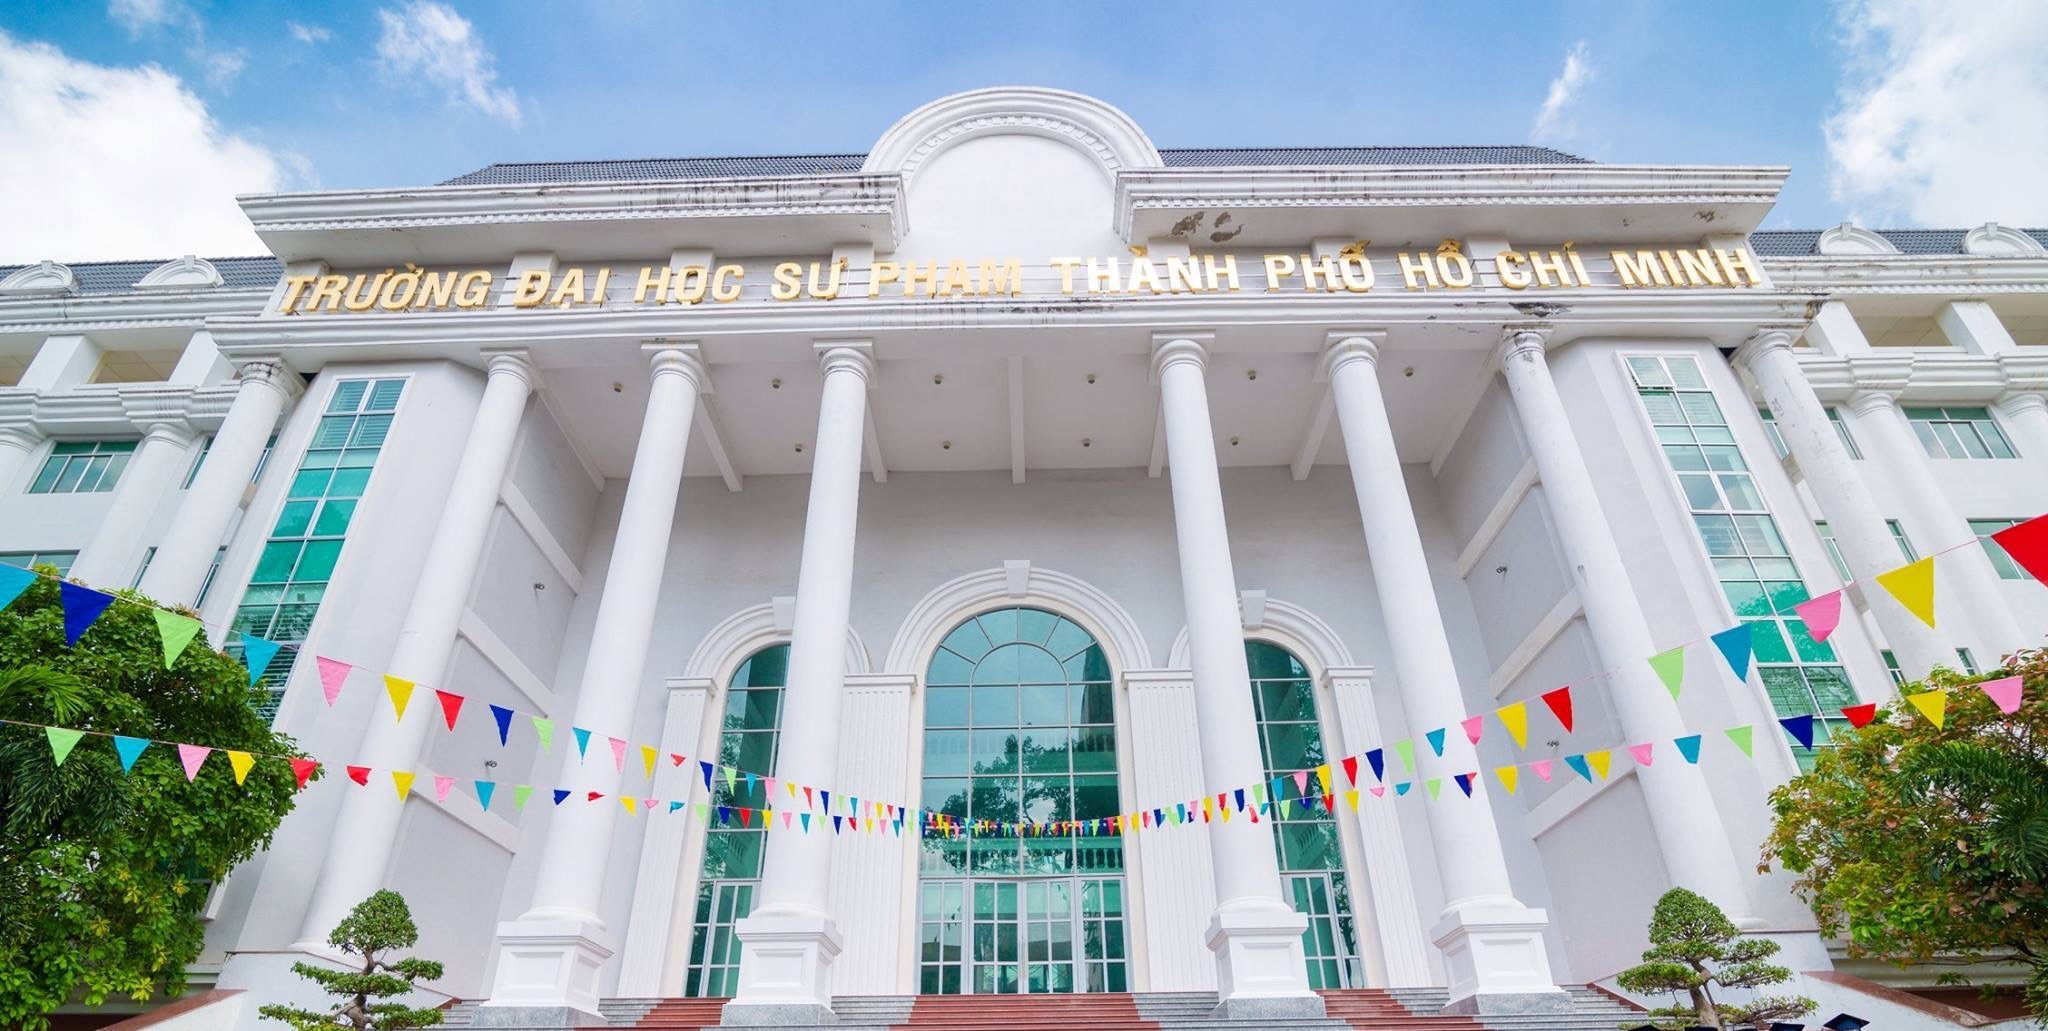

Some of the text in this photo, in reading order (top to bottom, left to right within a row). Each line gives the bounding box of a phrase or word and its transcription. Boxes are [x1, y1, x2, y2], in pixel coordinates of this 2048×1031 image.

[278, 239, 1761, 314] TRƯỜNG ĐẠI HỌC SƯ PHẠM THÀNH PHỐ HỒ CHÍ MINH
